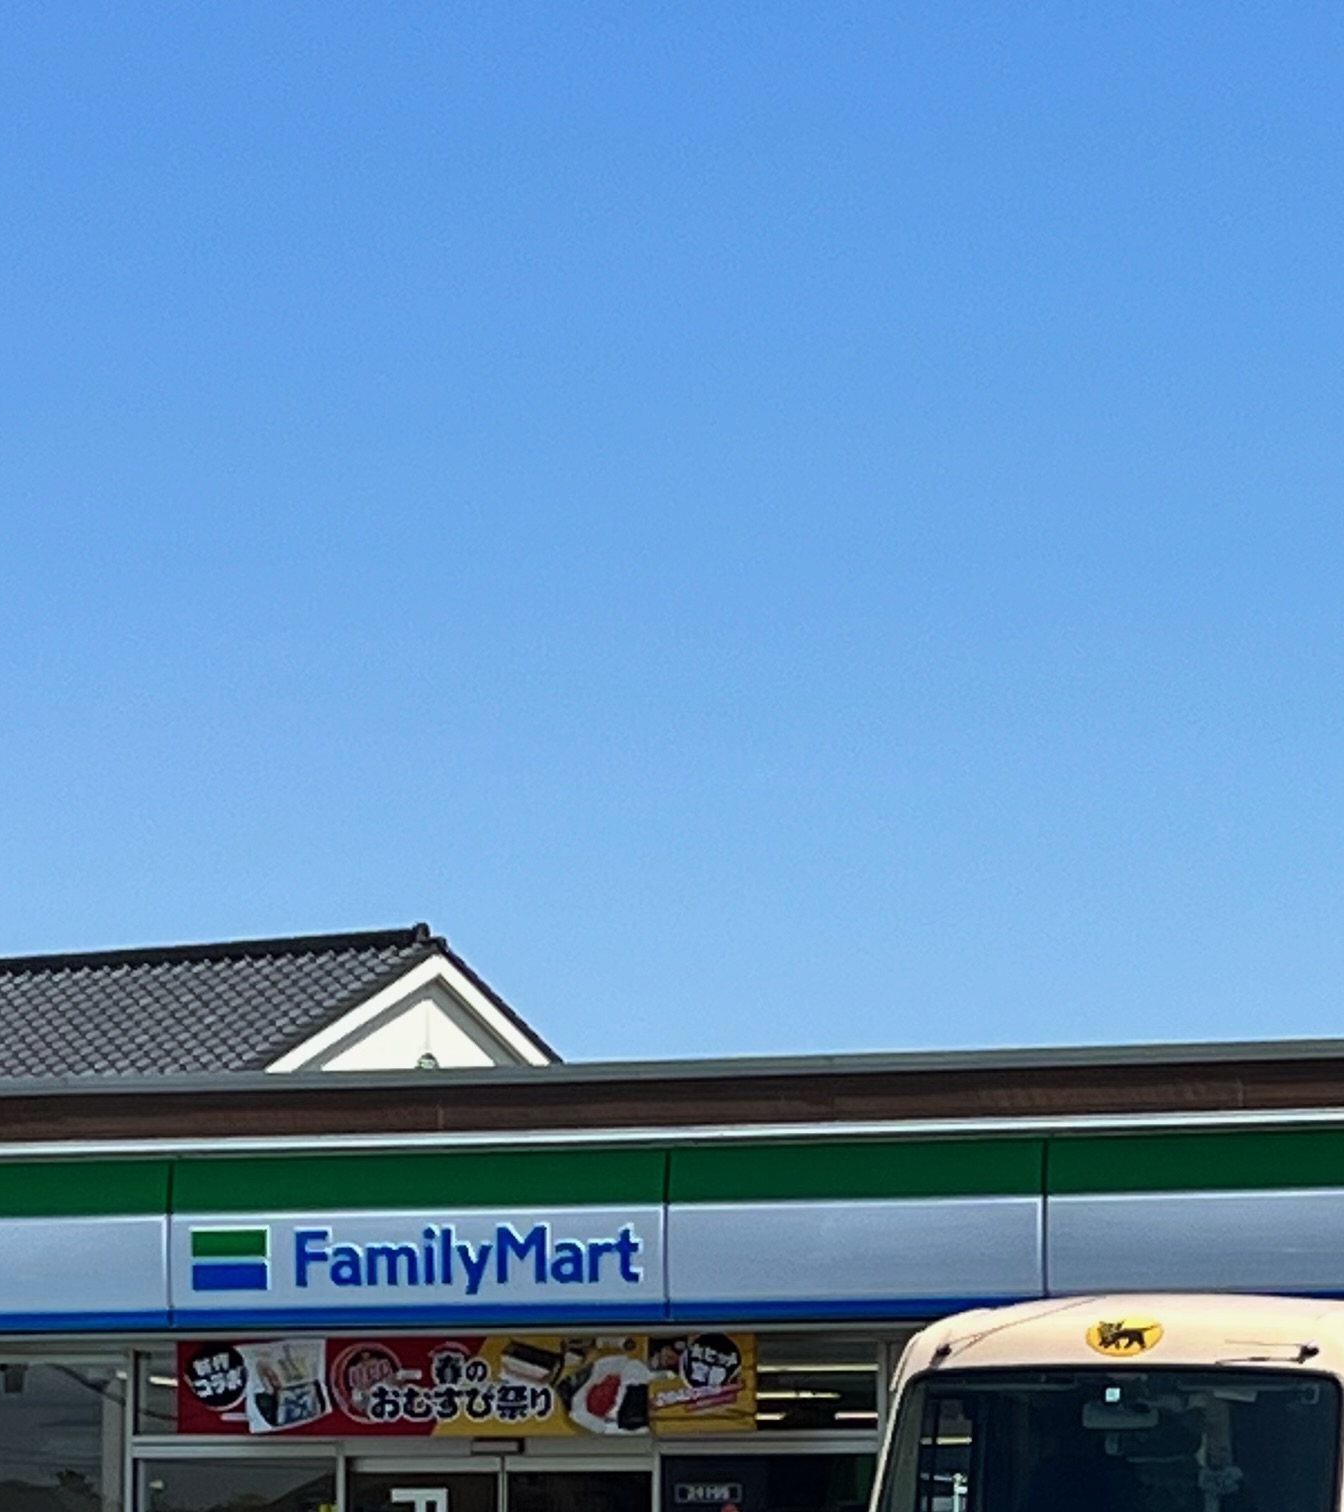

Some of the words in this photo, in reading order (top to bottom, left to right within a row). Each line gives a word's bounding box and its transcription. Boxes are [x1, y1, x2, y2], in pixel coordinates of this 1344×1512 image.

[294, 1223, 643, 1296] FamilyMart
[369, 1383, 553, 1422] おむすび祭り
